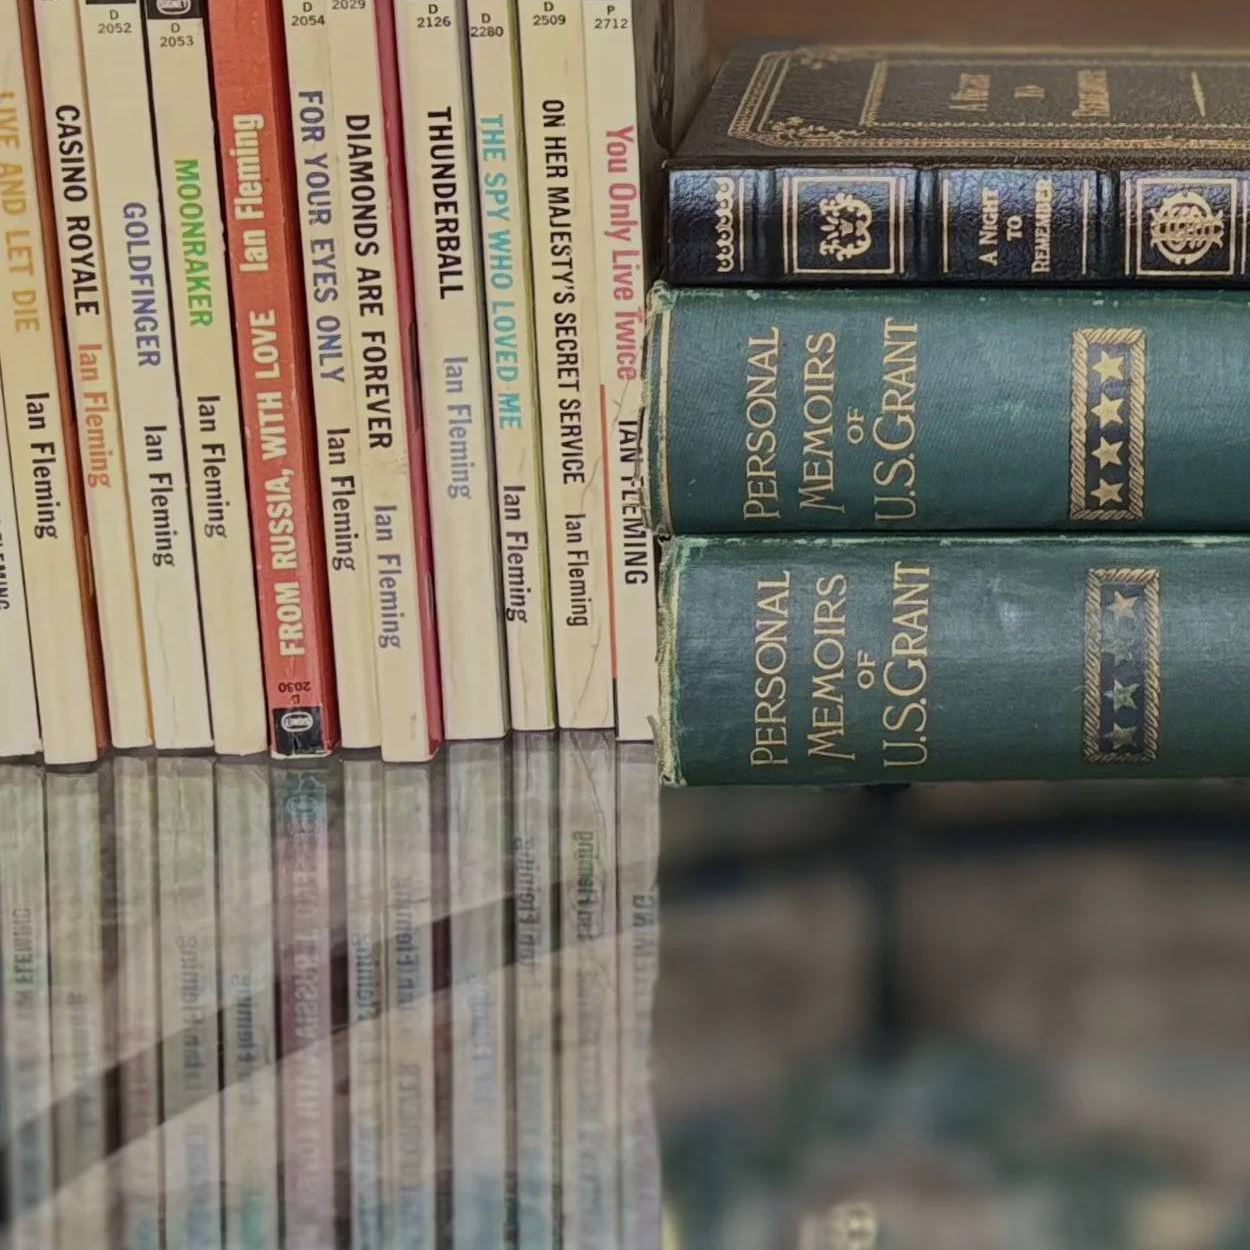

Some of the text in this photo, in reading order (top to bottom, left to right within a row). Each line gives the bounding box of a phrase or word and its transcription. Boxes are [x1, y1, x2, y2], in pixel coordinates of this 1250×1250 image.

[98, 23, 132, 34] 2052
[110, 10, 119, 20] D
[160, 36, 194, 47] 2053
[171, 23, 180, 33] D
[291, 15, 325, 26] 2054
[303, 1, 312, 12] D
[417, 17, 451, 28] 2126
[428, 4, 438, 14] D
[470, 27, 504, 38] 2280
[481, 13, 491, 24] D
[533, 15, 566, 26] 2509
[544, 1, 554, 12] D
[594, 18, 628, 29] 2712
[607, 5, 615, 15] P
[0, 161, 27, 217] AND
[56, 104, 99, 316] CASINO ROYALE
[229, 113, 269, 273] Ian Fleming
[298, 90, 345, 383] FOR YOUR EYES ONLY
[427, 106, 464, 300] THUNDERBALL
[978, 186, 999, 266] A NIGHT
[1006, 215, 1023, 241] TO
[1031, 178, 1053, 273] REMEMBER
[5, 230, 34, 277] LET
[122, 202, 161, 367] GOLDFINGER
[174, 158, 213, 328] MOONRAKER
[345, 114, 394, 449] DIAMONDS ARE FOREVER
[480, 113, 523, 430] THE SPY WHO LOVED ME
[542, 99, 586, 485] ON HER MAJESTY'S SECRET SERVICE
[604, 125, 644, 381] You Only Live Twice
[12, 289, 40, 333] DIE
[25, 392, 62, 540] Ian Fleming
[77, 343, 115, 488] Ian Fleming
[197, 395, 231, 539] Ian Fleming
[444, 356, 475, 500] Ian Fleming
[618, 421, 643, 463] IAN
[743, 327, 781, 520] PERSONAL
[798, 331, 845, 514] MEMOIRS
[847, 406, 865, 444] OF
[144, 425, 179, 568] Ian Fleming
[249, 309, 305, 658] FROM RUSSIA, WITH LOVE
[326, 427, 359, 571] Ian Fleming
[374, 505, 405, 649] Ian Fleming
[503, 485, 533, 623] Ian Fleming
[564, 513, 592, 627] Ian Fleming
[278, 681, 312, 693] 2030
[750, 571, 790, 766] PERSONAL
[808, 574, 856, 762] MEMOIRS
[857, 650, 875, 689] OF
